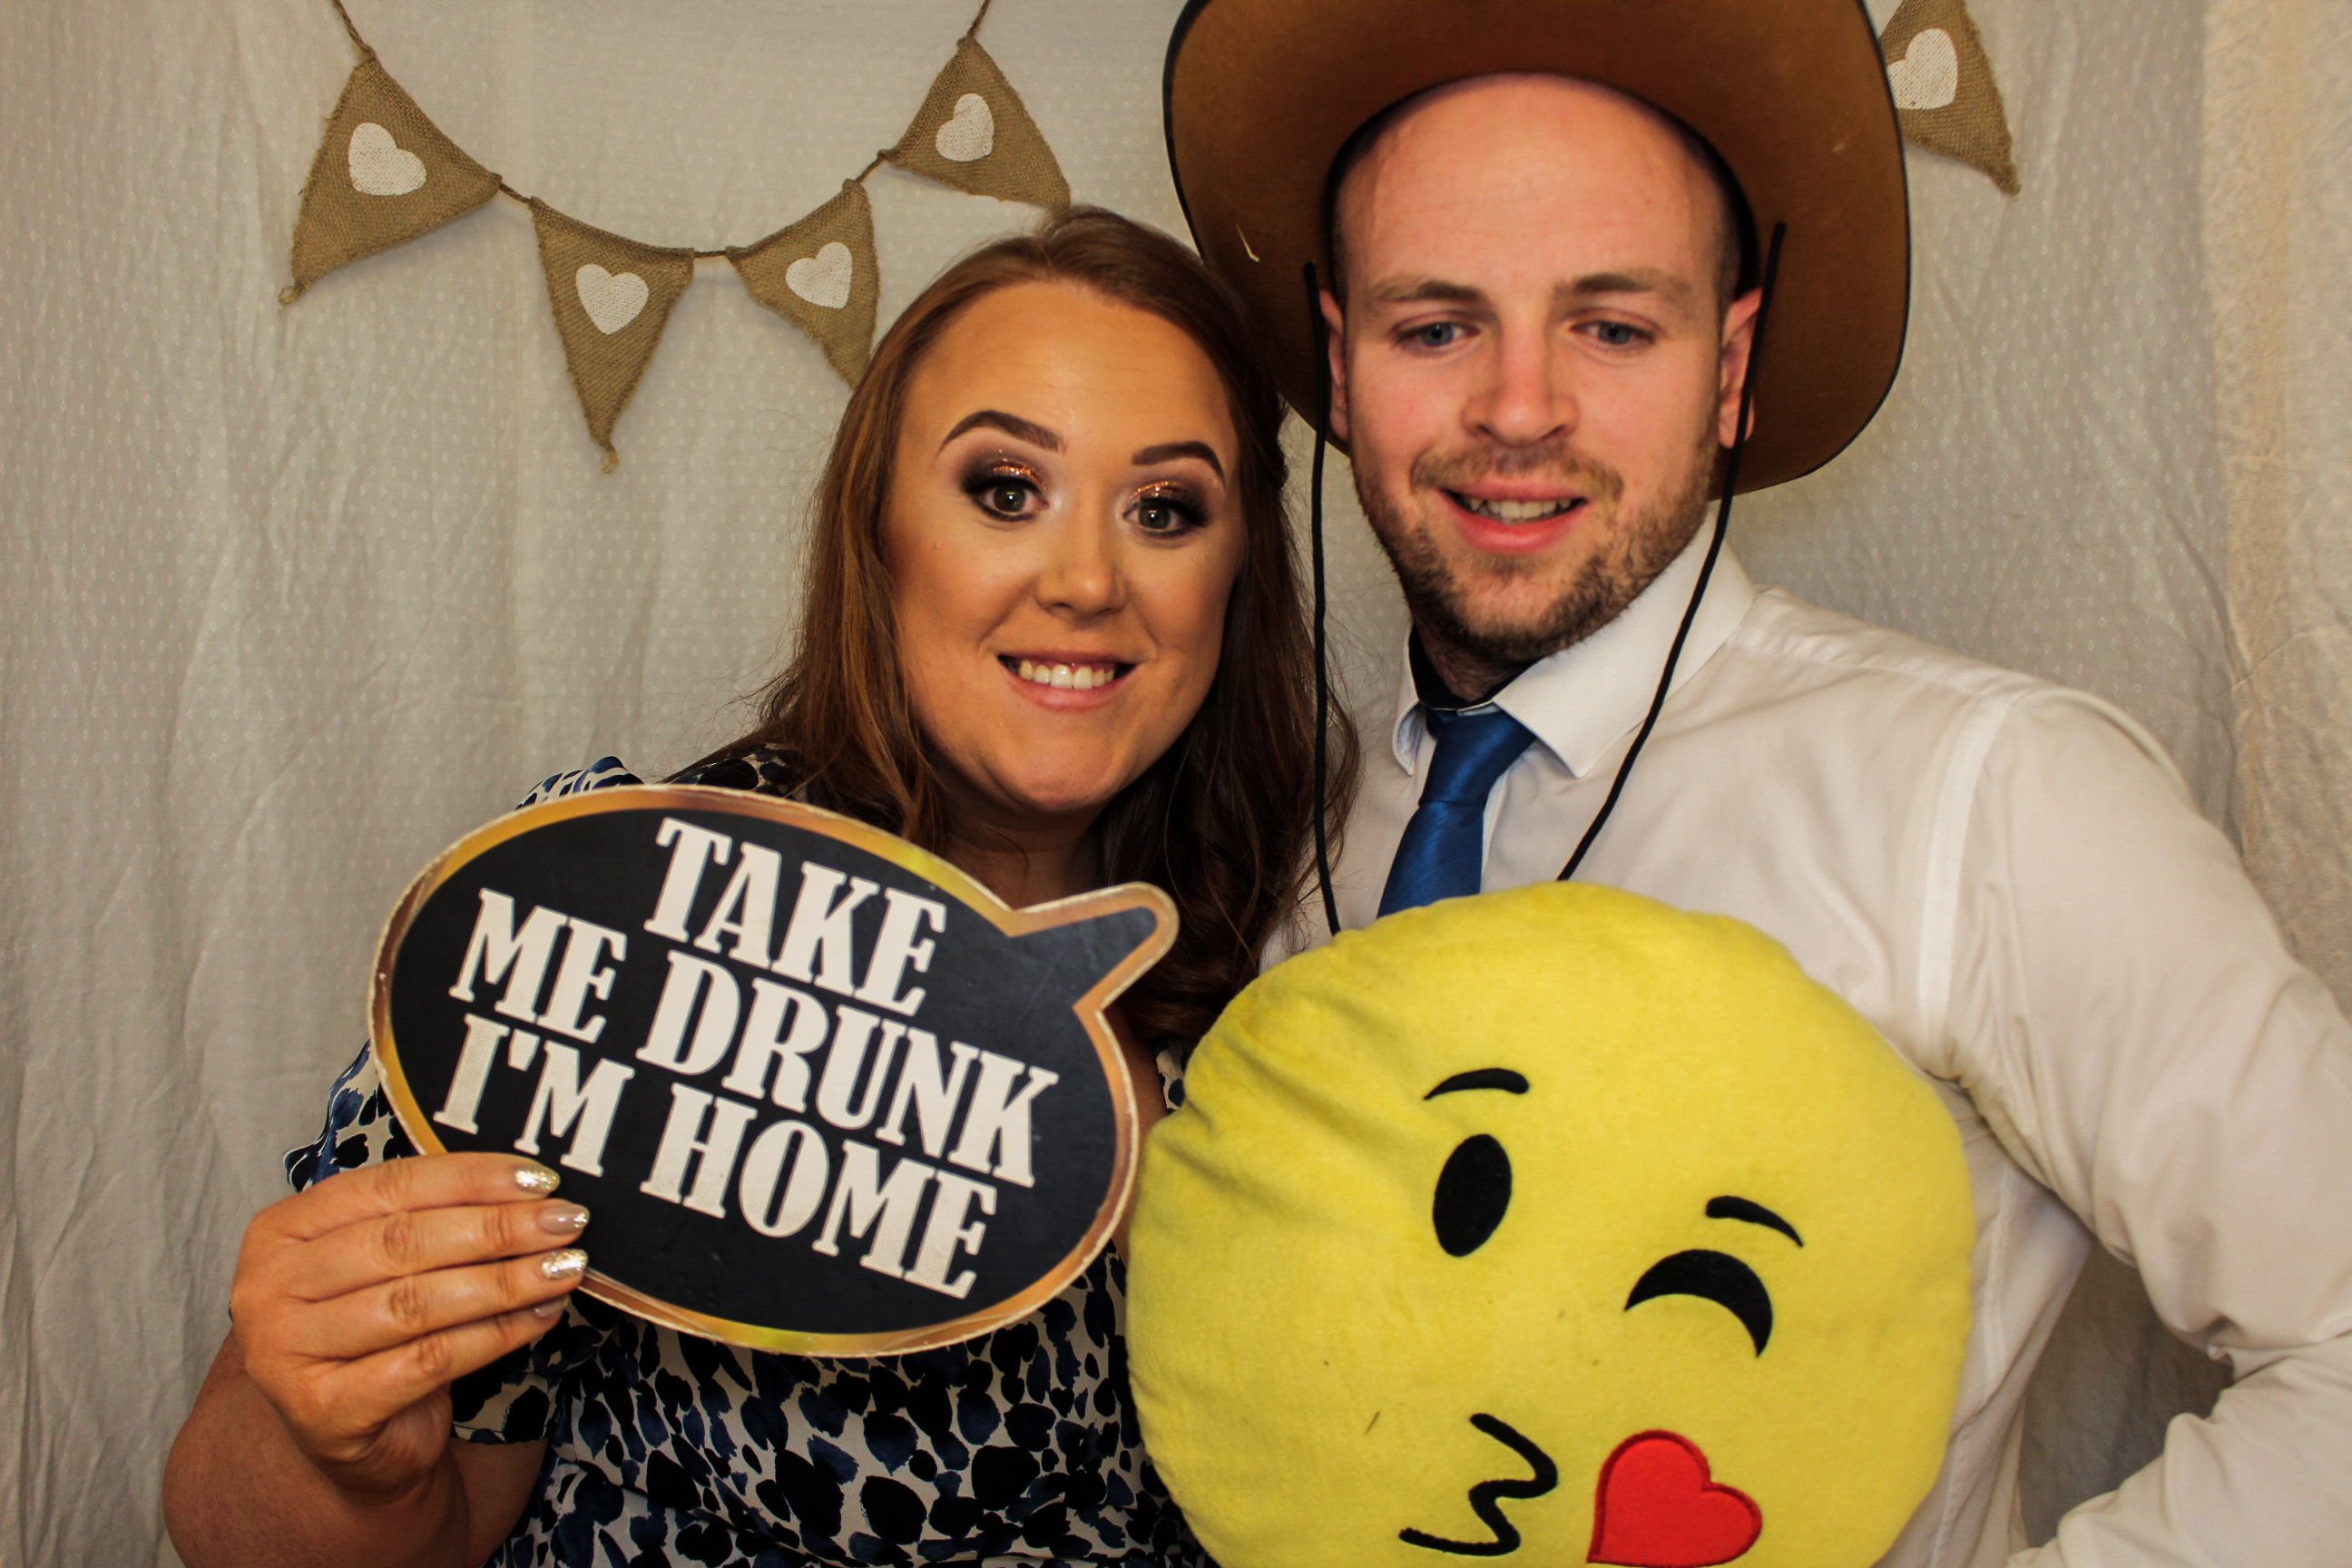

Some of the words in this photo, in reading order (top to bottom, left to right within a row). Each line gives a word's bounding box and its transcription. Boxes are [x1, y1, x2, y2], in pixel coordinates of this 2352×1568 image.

[448, 887, 627, 1044] ME
[635, 949, 1060, 1188] DRUNK
[643, 817, 946, 1016] TAKE
[433, 1013, 635, 1178] I'M
[640, 1083, 997, 1299] HOME
